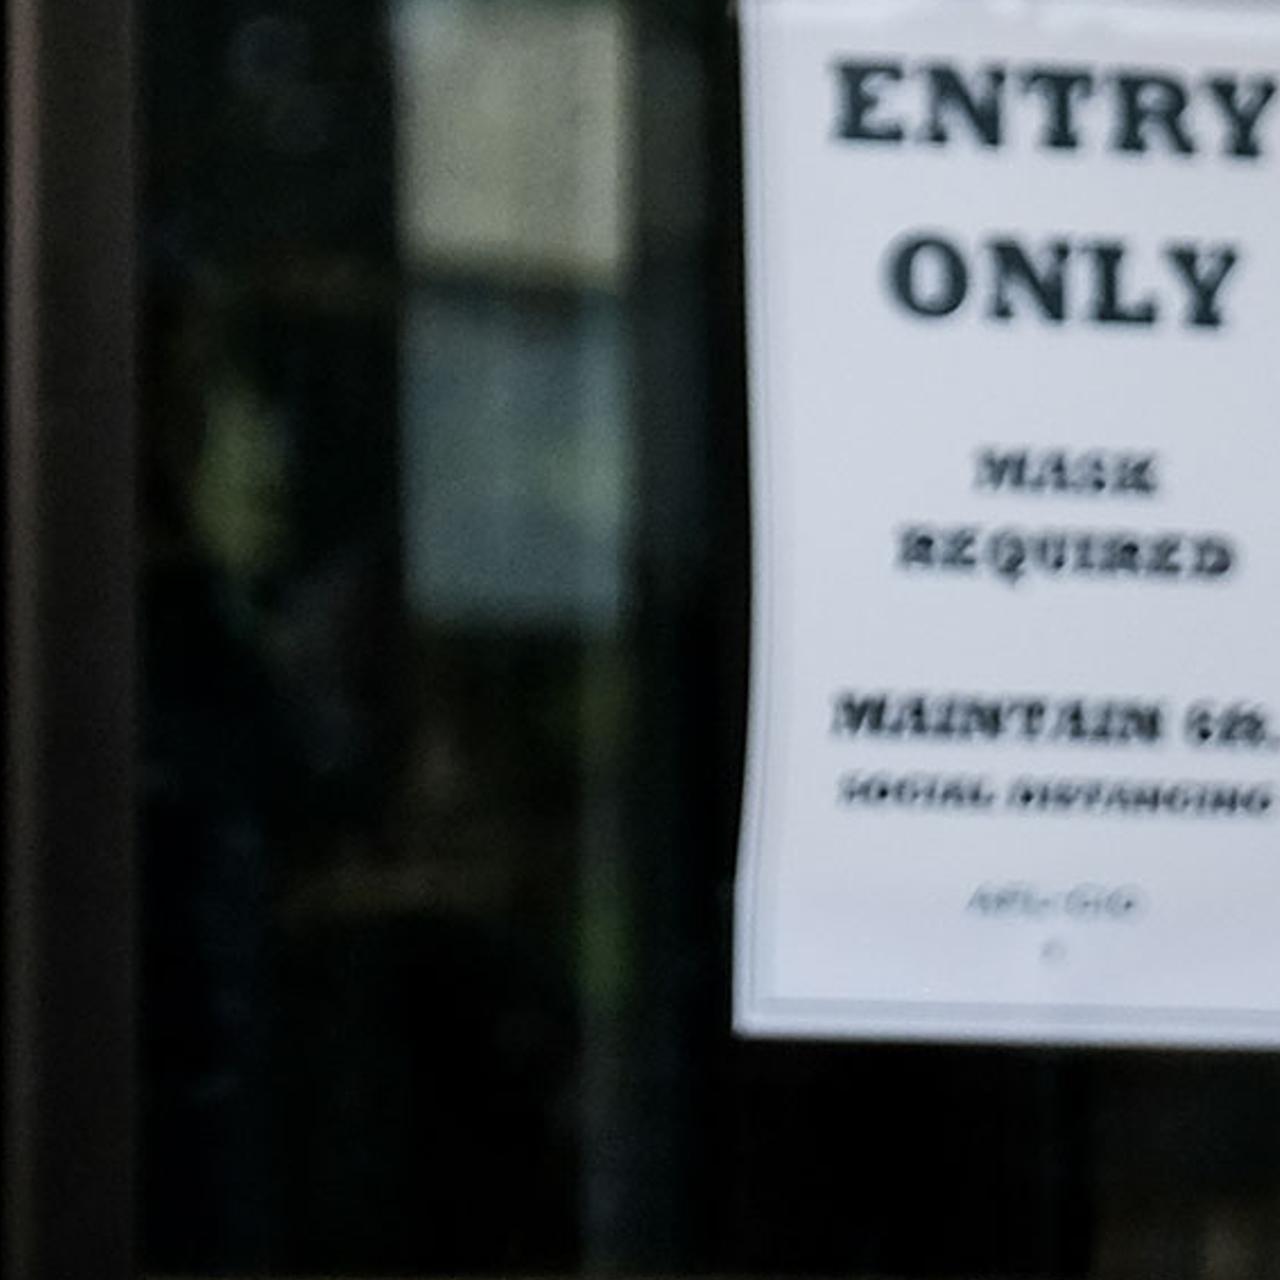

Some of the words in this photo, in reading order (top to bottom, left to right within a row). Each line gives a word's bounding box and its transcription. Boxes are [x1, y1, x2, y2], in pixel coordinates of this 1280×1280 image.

[834, 59, 1278, 160] ENTRY
[886, 232, 1239, 331] ONLY
[976, 448, 1158, 497] MASK
[898, 526, 1236, 584] REQUIRED
[833, 692, 1163, 744] MAINTAIN
[838, 775, 995, 808] SOCIAL
[1006, 780, 1273, 815] DISTANCING
